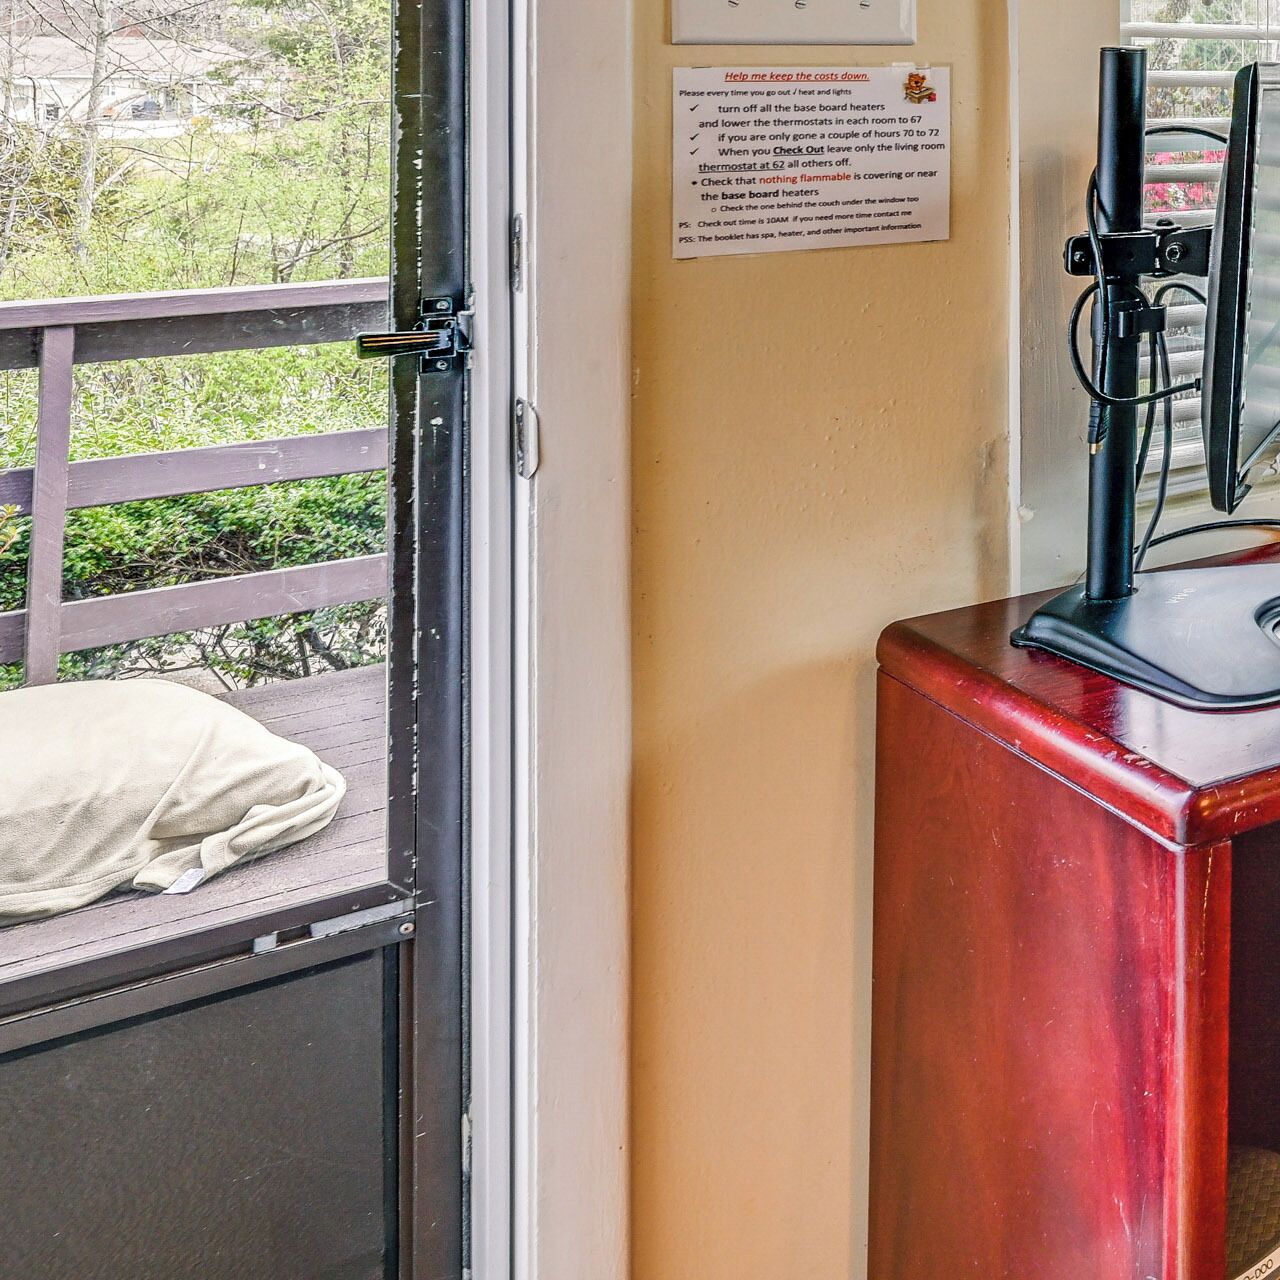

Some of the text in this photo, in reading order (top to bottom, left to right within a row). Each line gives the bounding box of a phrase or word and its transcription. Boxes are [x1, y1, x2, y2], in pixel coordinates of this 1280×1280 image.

[725, 72, 870, 81] Help me keep the costs down.
[832, 88, 852, 96] lights
[742, 104, 758, 113] off
[760, 104, 772, 112] all
[774, 104, 791, 112] the
[793, 104, 816, 112] base
[819, 103, 847, 112] board
[850, 103, 885, 111] heaters
[698, 119, 719, 128] and
[721, 119, 751, 128] lower
[753, 118, 771, 127] the
[773, 118, 833, 127] thermostats
[835, 117, 844, 125] in
[846, 116, 869, 125] each
[910, 115, 922, 124] 67
[718, 133, 726, 141] if
[727, 135, 747, 144] you
[769, 132, 791, 142] only
[792, 133, 817, 142] gone
[828, 130, 860, 141] couple
[861, 130, 872, 139] of
[874, 130, 901, 138] hours
[903, 129, 914, 137] 70
[718, 147, 749, 156] When
[751, 149, 771, 157] you
[773, 145, 803, 156] Check
[805, 146, 825, 155] Out
[827, 145, 852, 153] leave
[854, 144, 876, 153] only
[876, 143, 893, 152] the
[895, 143, 919, 152] living
[699, 158, 851, 172] thermostat at 62 all others off.
[701, 177, 733, 186] Check
[734, 177, 756, 185] that
[759, 175, 798, 185] nothing
[800, 173, 851, 182] flammable
[854, 172, 861, 180] is
[863, 171, 903, 182] covering
[701, 189, 819, 201] the base board heaters
[776, 201, 803, 209] behind
[841, 199, 863, 207] under
[697, 220, 721, 228] Check
[766, 216, 789, 224] 10AM
[815, 214, 833, 222] need
[822, 227, 843, 235] other
[844, 226, 880, 234] important
[881, 222, 922, 231] information
